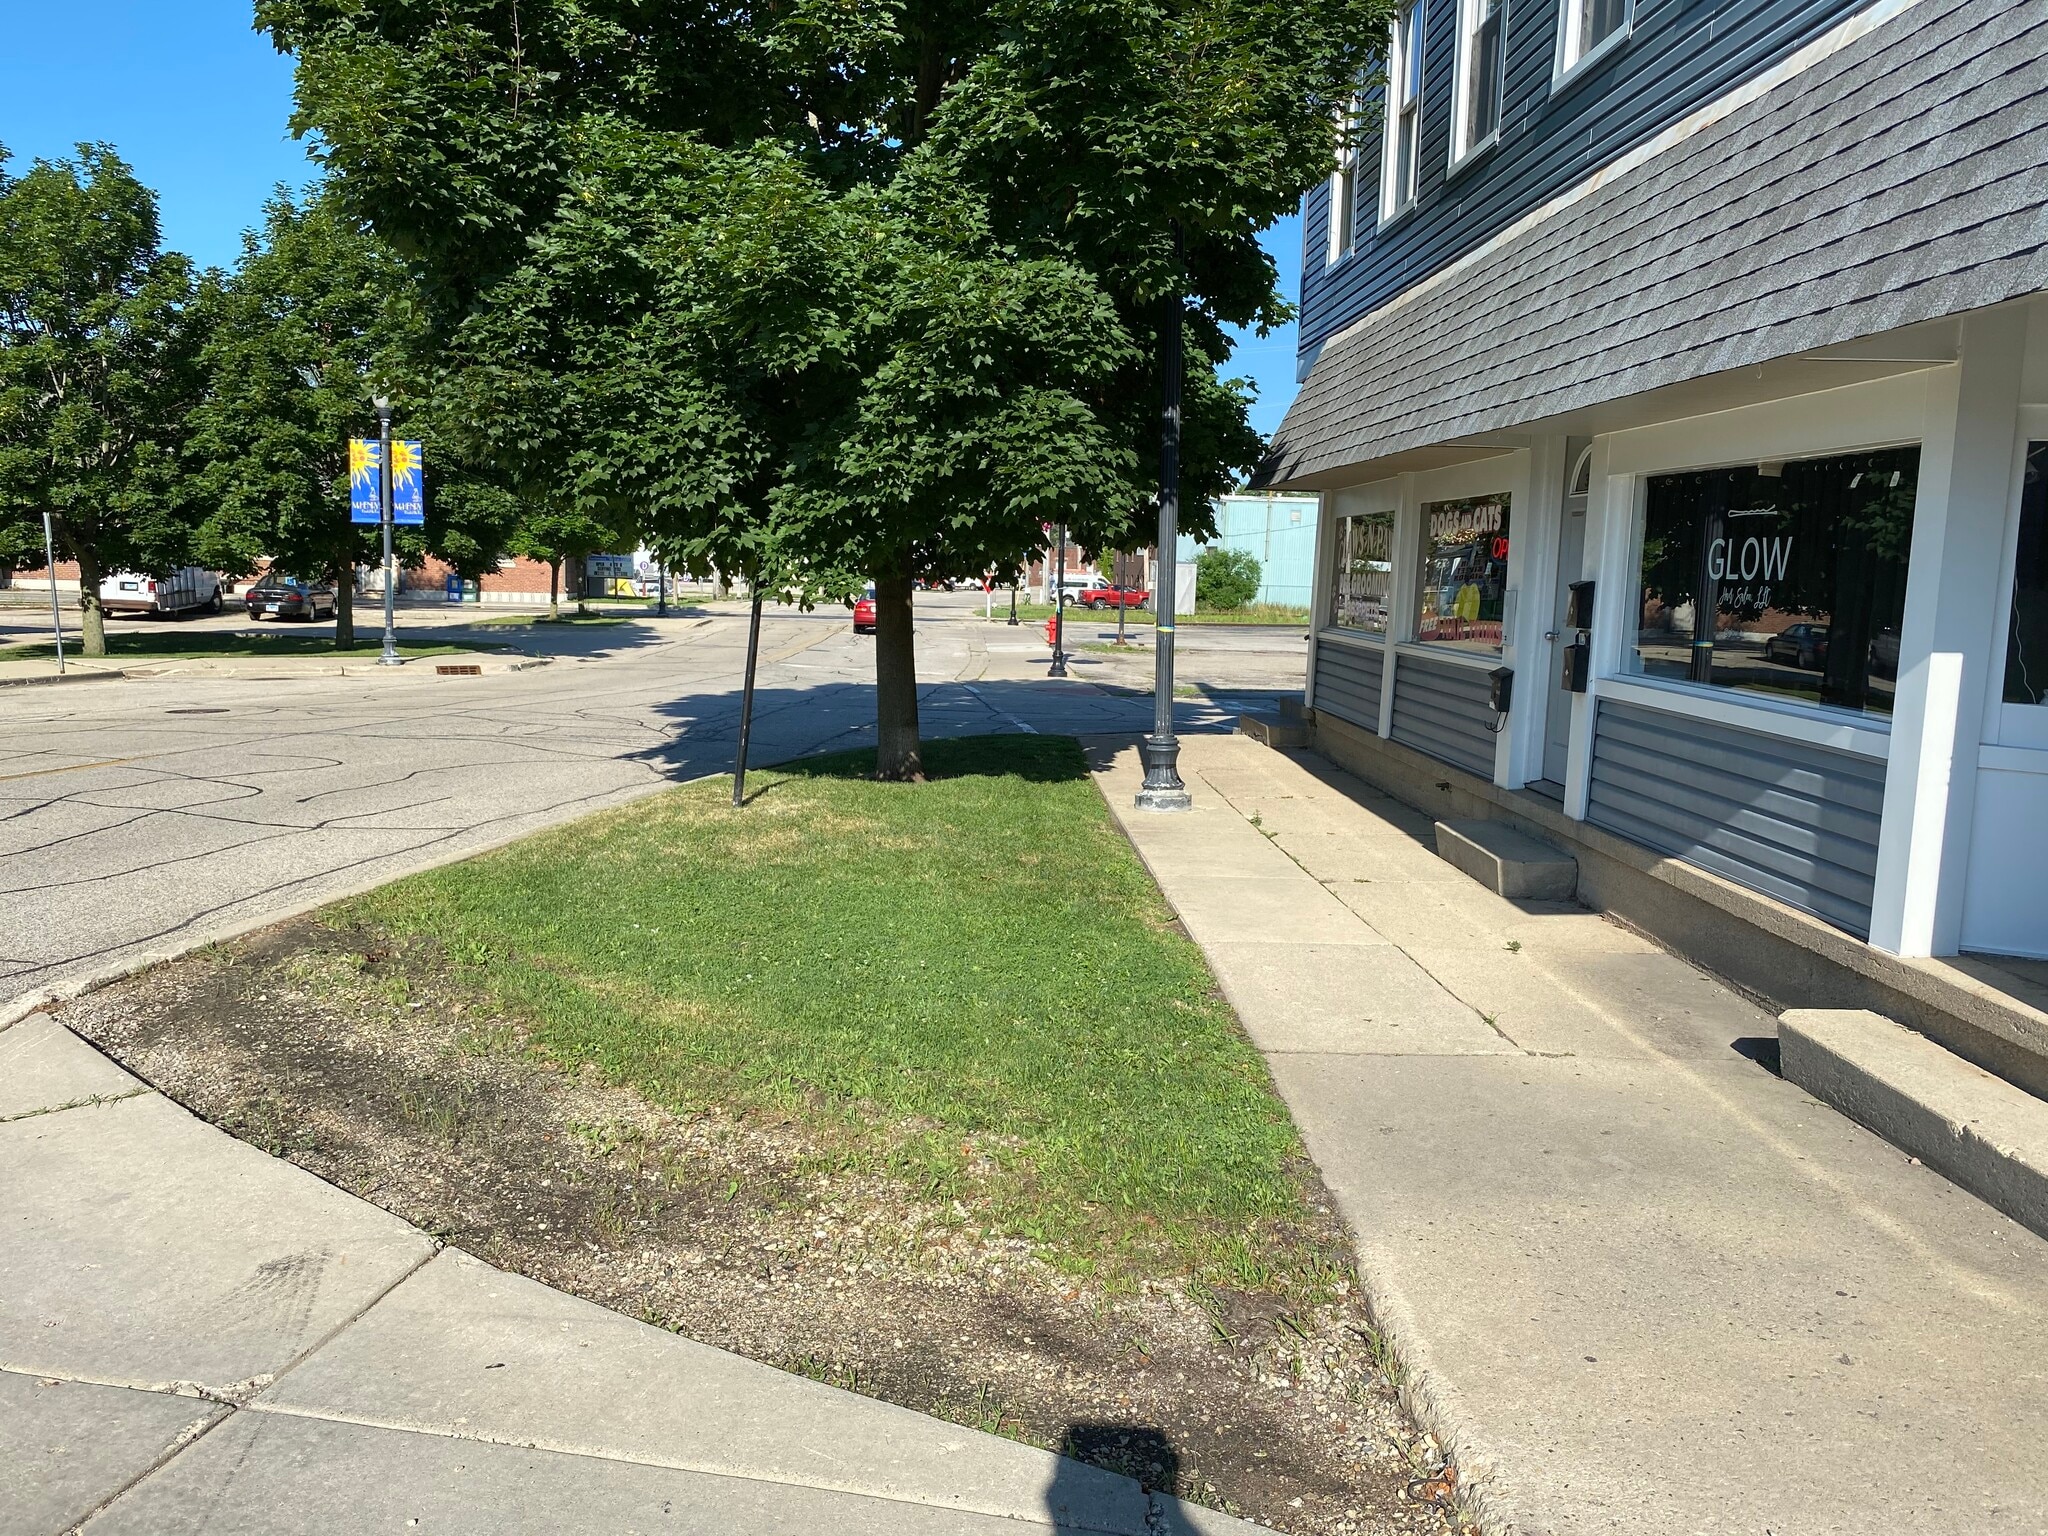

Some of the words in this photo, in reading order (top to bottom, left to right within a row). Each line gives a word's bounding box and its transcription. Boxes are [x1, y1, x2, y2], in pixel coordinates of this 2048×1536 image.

[1430, 510, 1460, 537] DOGS
[1461, 514, 1472, 529] AND
[1473, 505, 1502, 533] CATS
[1492, 537, 1510, 559] OP
[1708, 536, 1793, 581] GLOW
[1419, 615, 1439, 633] FREE
